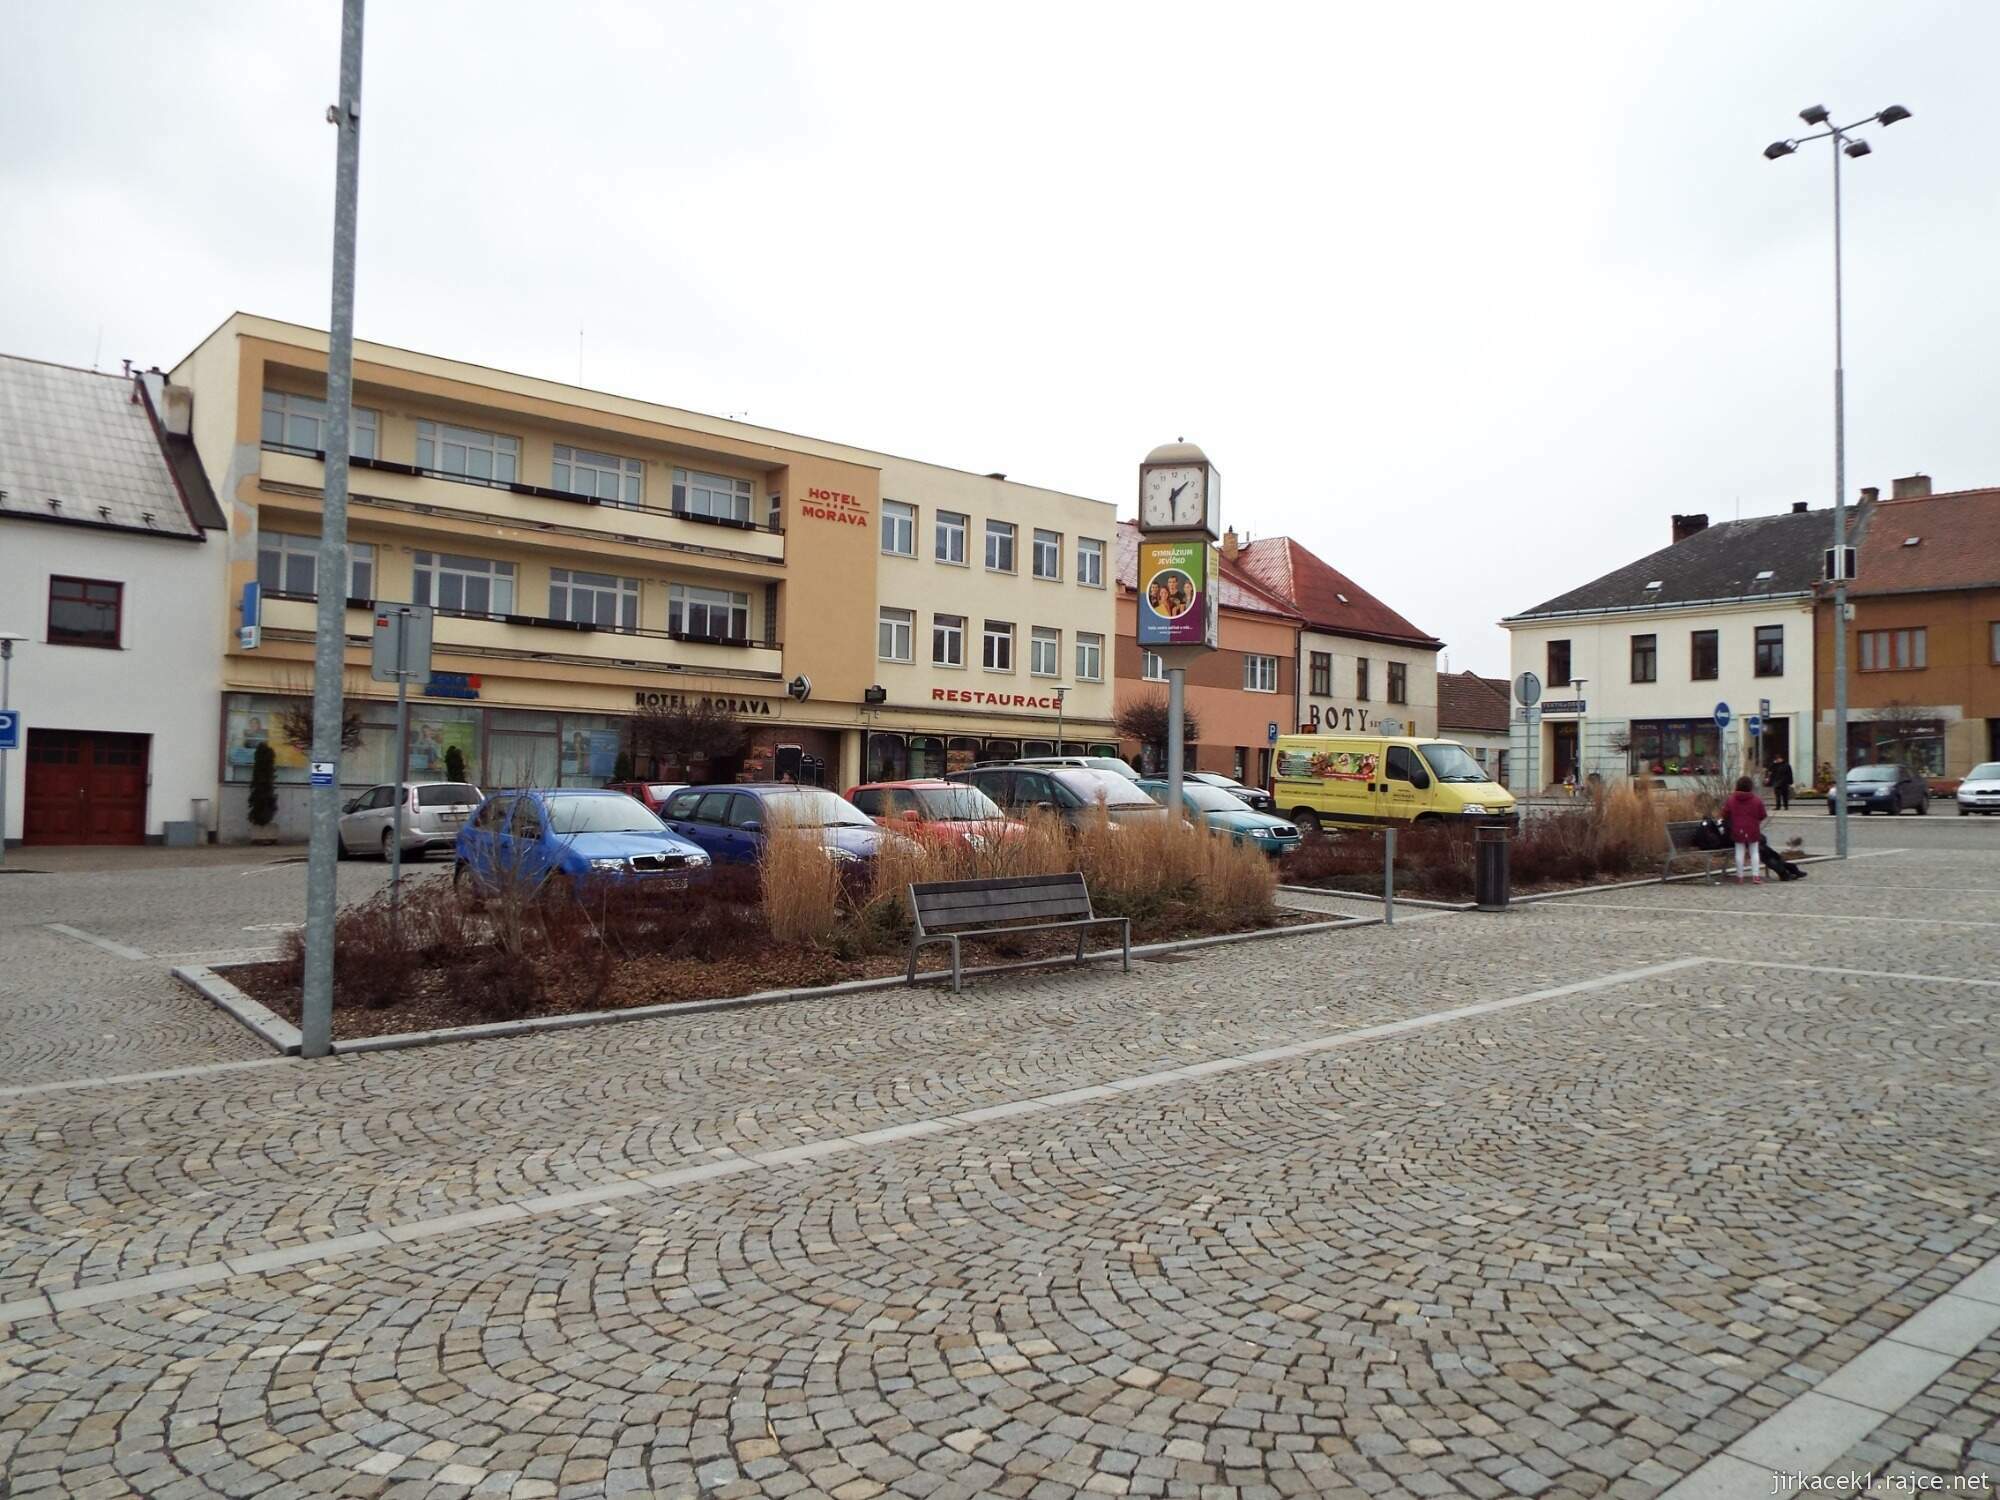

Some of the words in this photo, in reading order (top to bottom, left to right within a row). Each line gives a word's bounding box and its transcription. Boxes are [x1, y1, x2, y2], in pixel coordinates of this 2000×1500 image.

[808, 487, 861, 506] HOTEL
[802, 505, 867, 527] MORAVA
[635, 692, 687, 709] HOTEL
[702, 697, 770, 714] MORAVA
[932, 688, 1062, 710] RESTAURACE
[1309, 704, 1369, 732] BOTY
[1269, 725, 1276, 737] P
